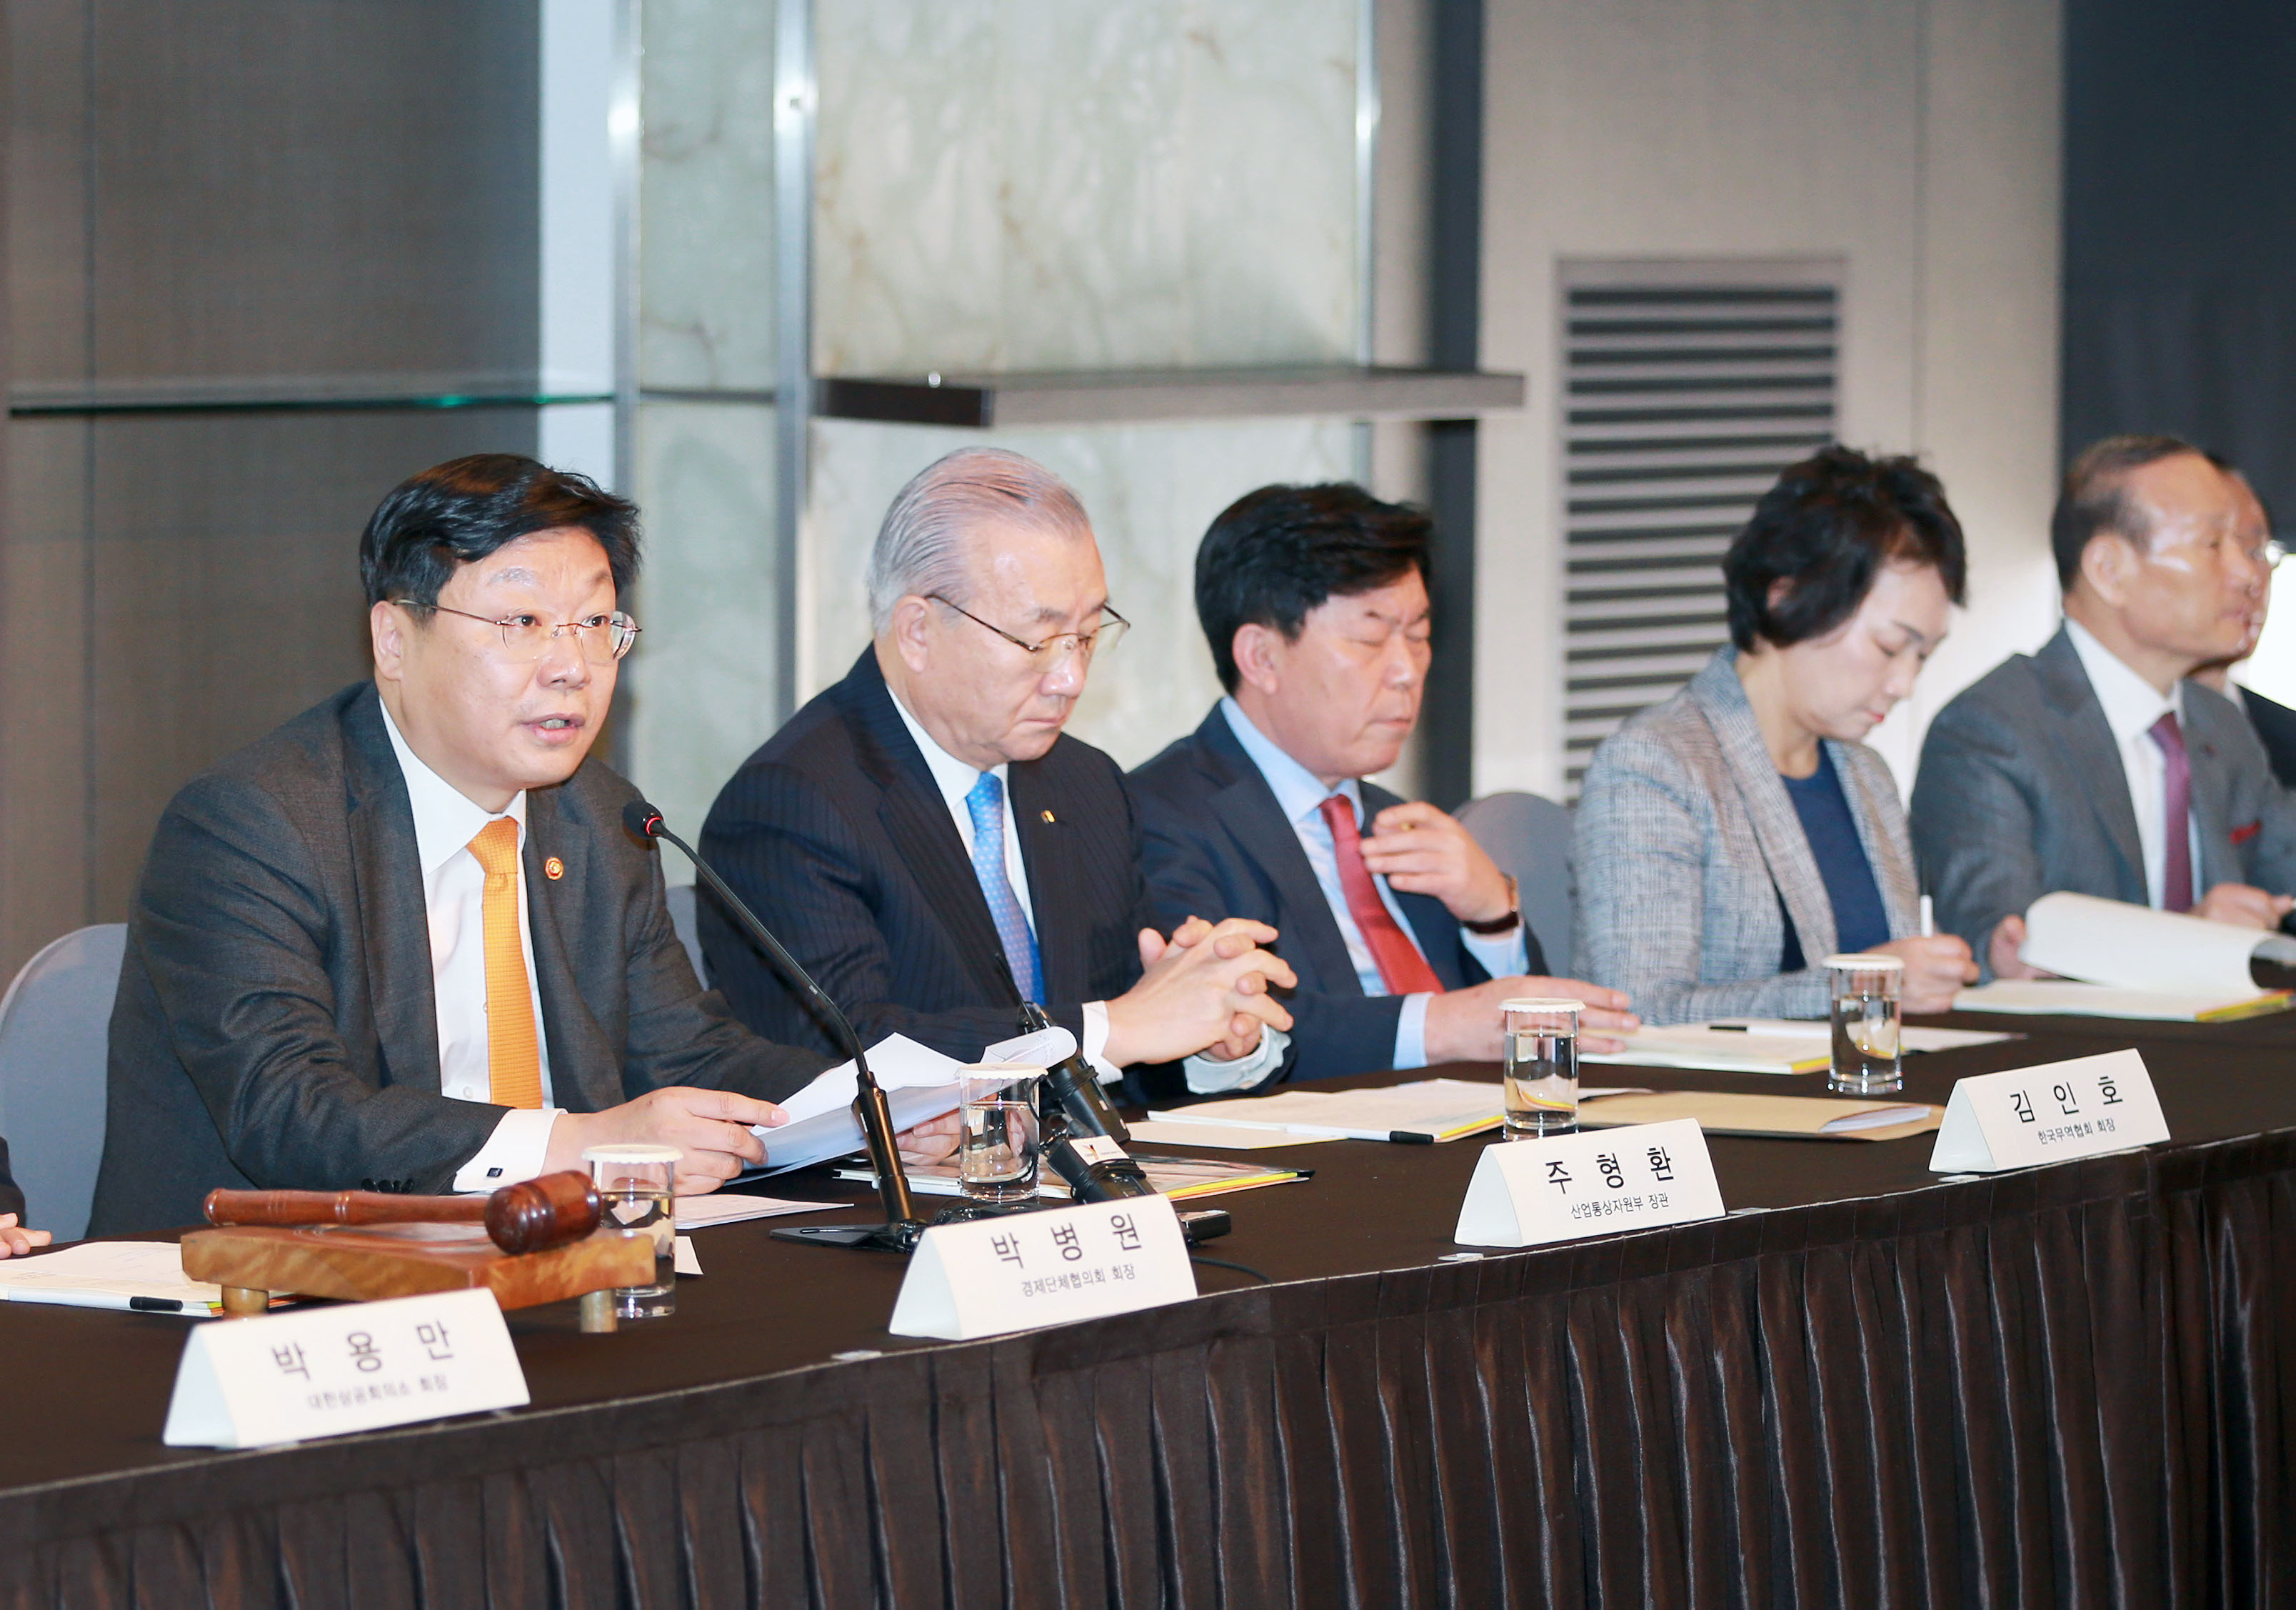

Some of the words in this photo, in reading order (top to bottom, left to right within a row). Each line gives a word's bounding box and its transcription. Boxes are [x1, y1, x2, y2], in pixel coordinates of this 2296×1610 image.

[2037, 1122, 2093, 1144] 한국무역협회
[2097, 1119, 2115, 1131] 회장
[1571, 1196, 1643, 1219] 산업통상자원부
[1648, 1193, 1668, 1209] 장관
[1021, 1269, 1106, 1297] 경제단체협의회
[1112, 1264, 1135, 1280] 회장
